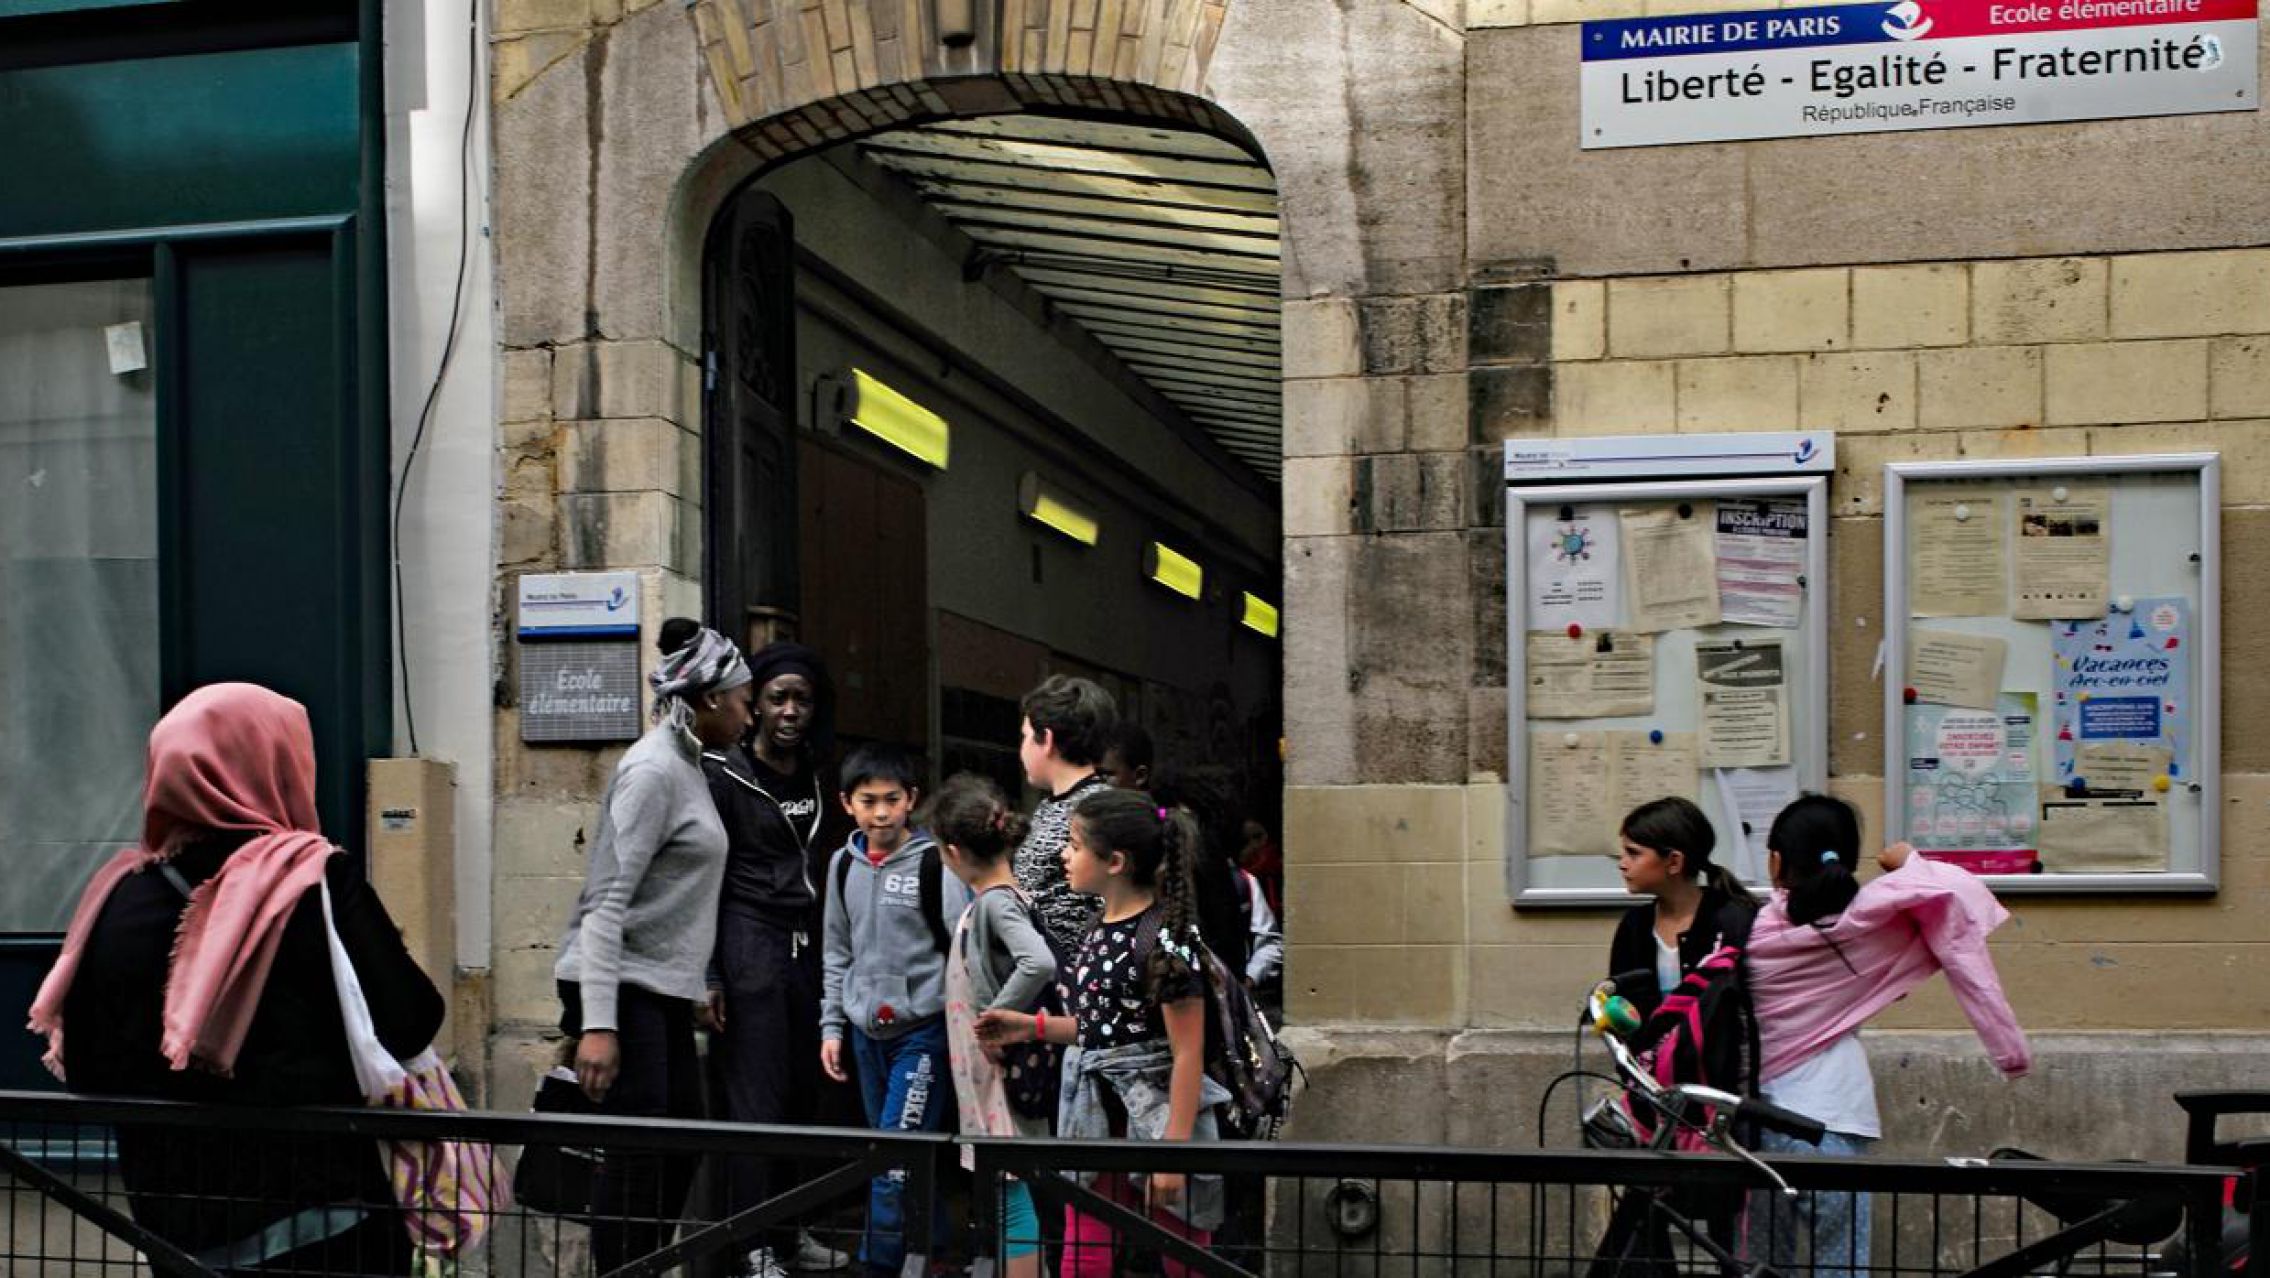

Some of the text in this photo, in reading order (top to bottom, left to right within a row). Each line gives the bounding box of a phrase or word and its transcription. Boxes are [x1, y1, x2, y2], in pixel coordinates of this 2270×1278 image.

[1989, 0, 2201, 26] Ecole élémentaire
[1620, 15, 1841, 49] MAIRIE DE PARIS
[1622, 63, 1765, 103] Liberté
[1811, 51, 1948, 98] Egalité
[1993, 34, 2206, 81] Fraternité
[1801, 95, 2017, 124] République Française
[557, 663, 602, 691] École
[2072, 656, 2170, 673] Vacances
[2069, 671, 2170, 688] Arc-en-ciel
[528, 692, 631, 715] élémentaire
[885, 874, 920, 895] 62
